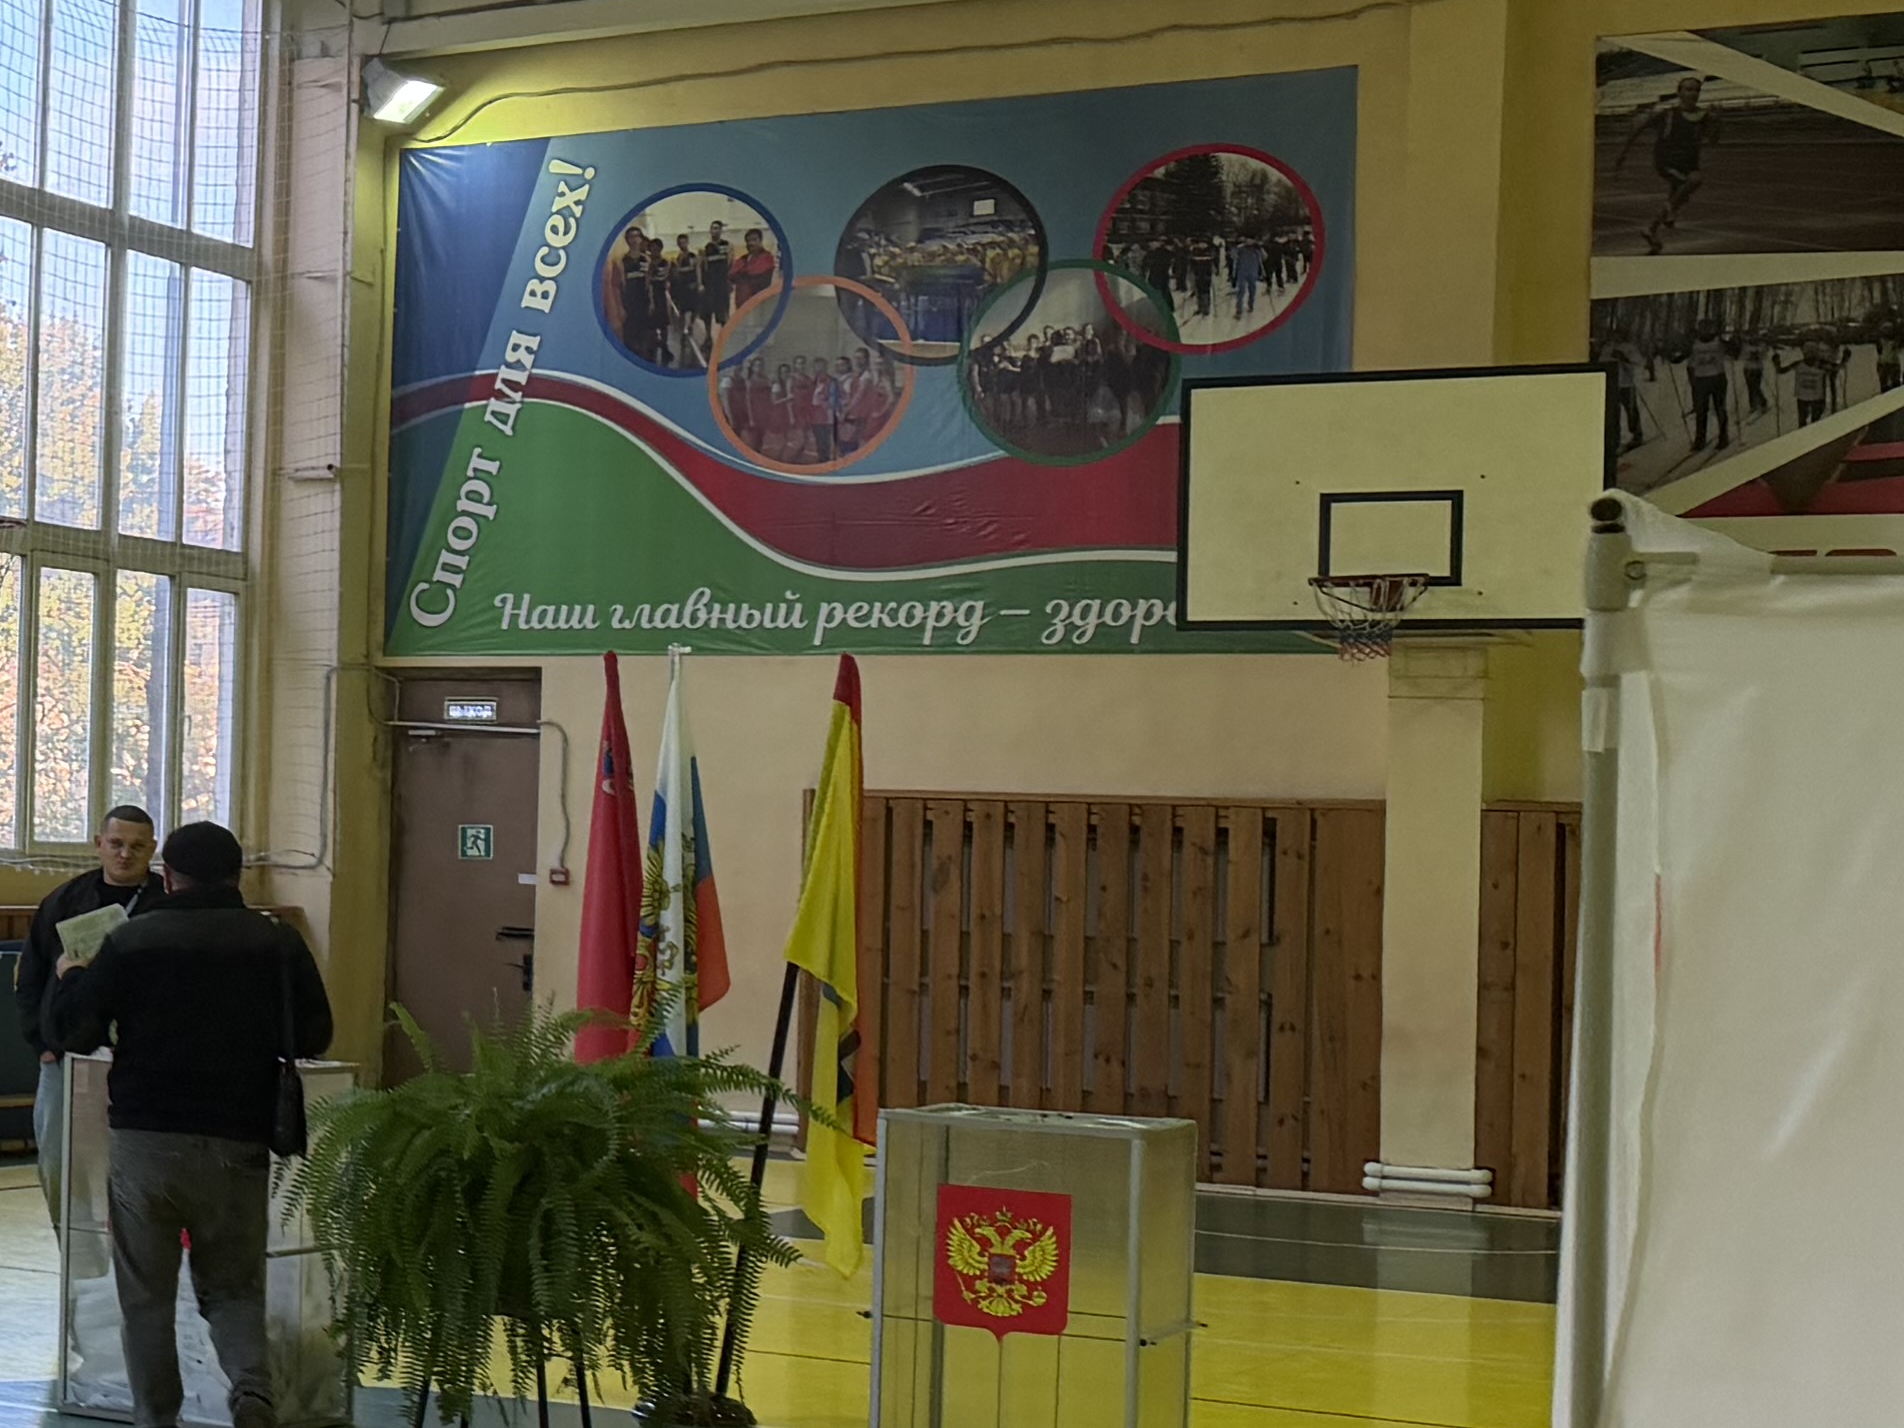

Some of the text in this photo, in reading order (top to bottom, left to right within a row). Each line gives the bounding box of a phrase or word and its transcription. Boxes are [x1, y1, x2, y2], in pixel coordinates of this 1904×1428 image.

[409, 158, 596, 628] Спорт для всех!
[494, 592, 600, 630] Наш
[609, 586, 810, 630] главный
[813, 599, 996, 646] рекорд
[449, 705, 493, 718] ВЫХОД
